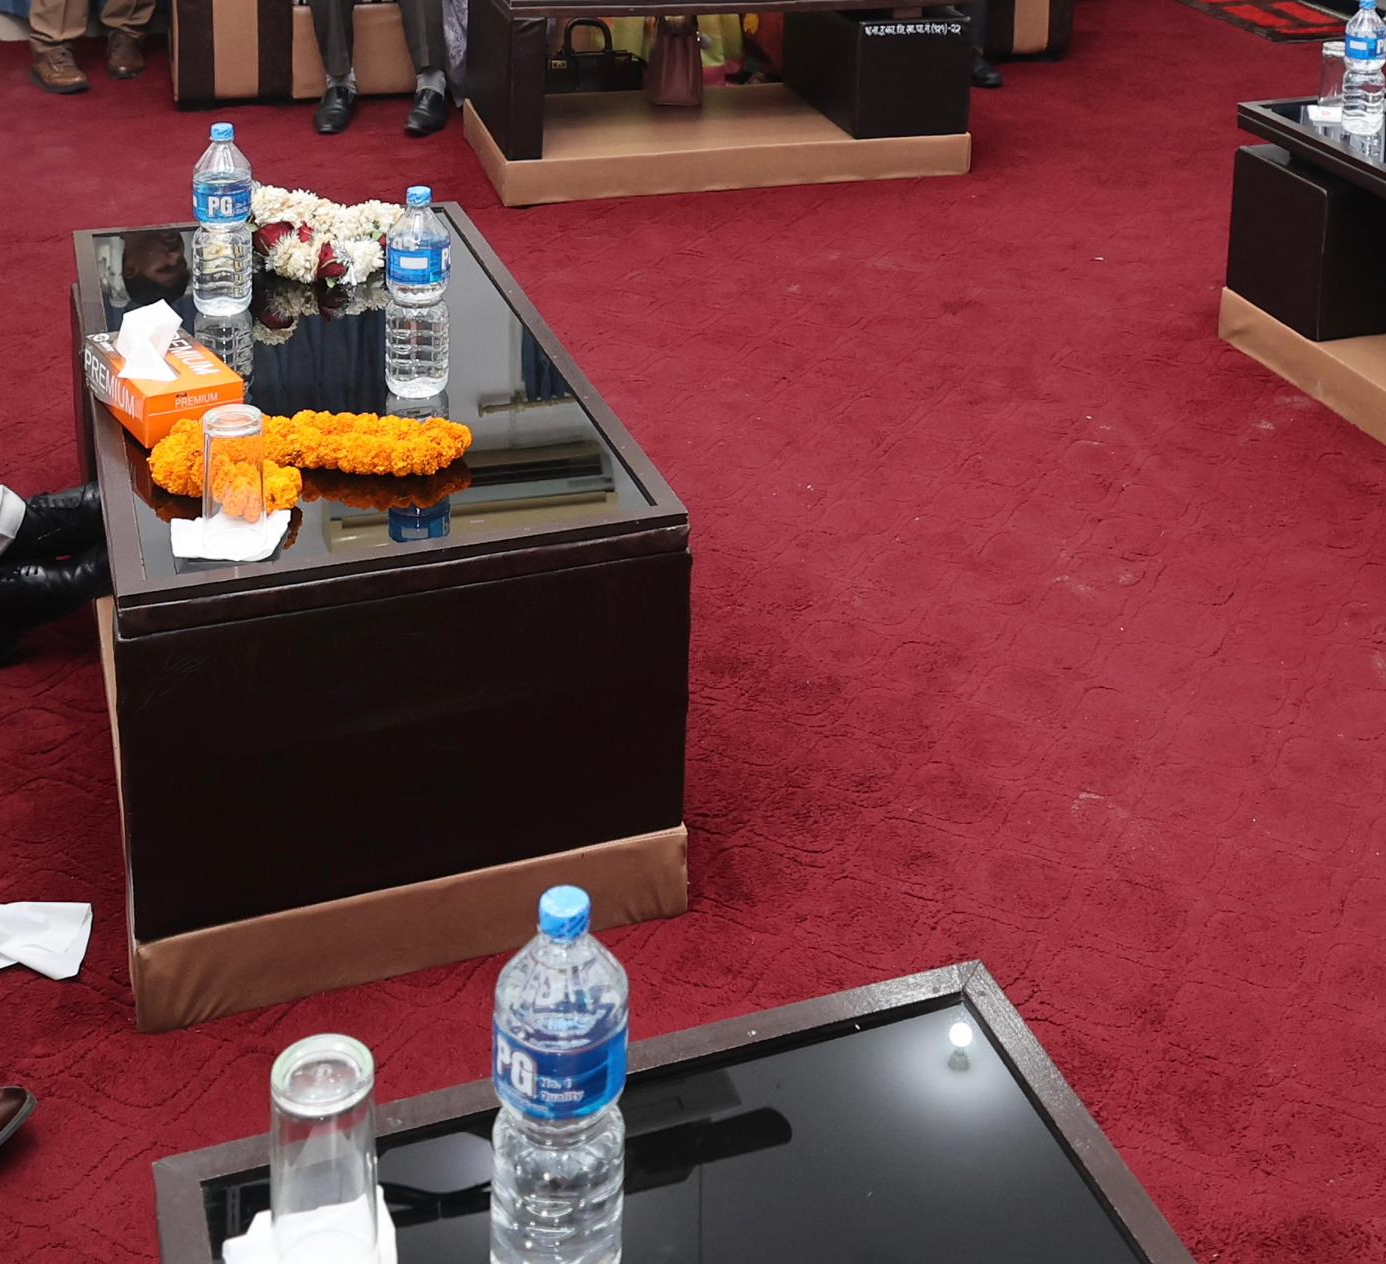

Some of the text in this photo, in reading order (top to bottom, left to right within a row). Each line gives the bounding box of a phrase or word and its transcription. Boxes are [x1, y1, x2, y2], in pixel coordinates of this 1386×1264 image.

[208, 196, 233, 217] PG
[84, 349, 136, 418] PREMIUM
[174, 392, 218, 408] PREMIUM
[497, 1034, 535, 1097] PG
